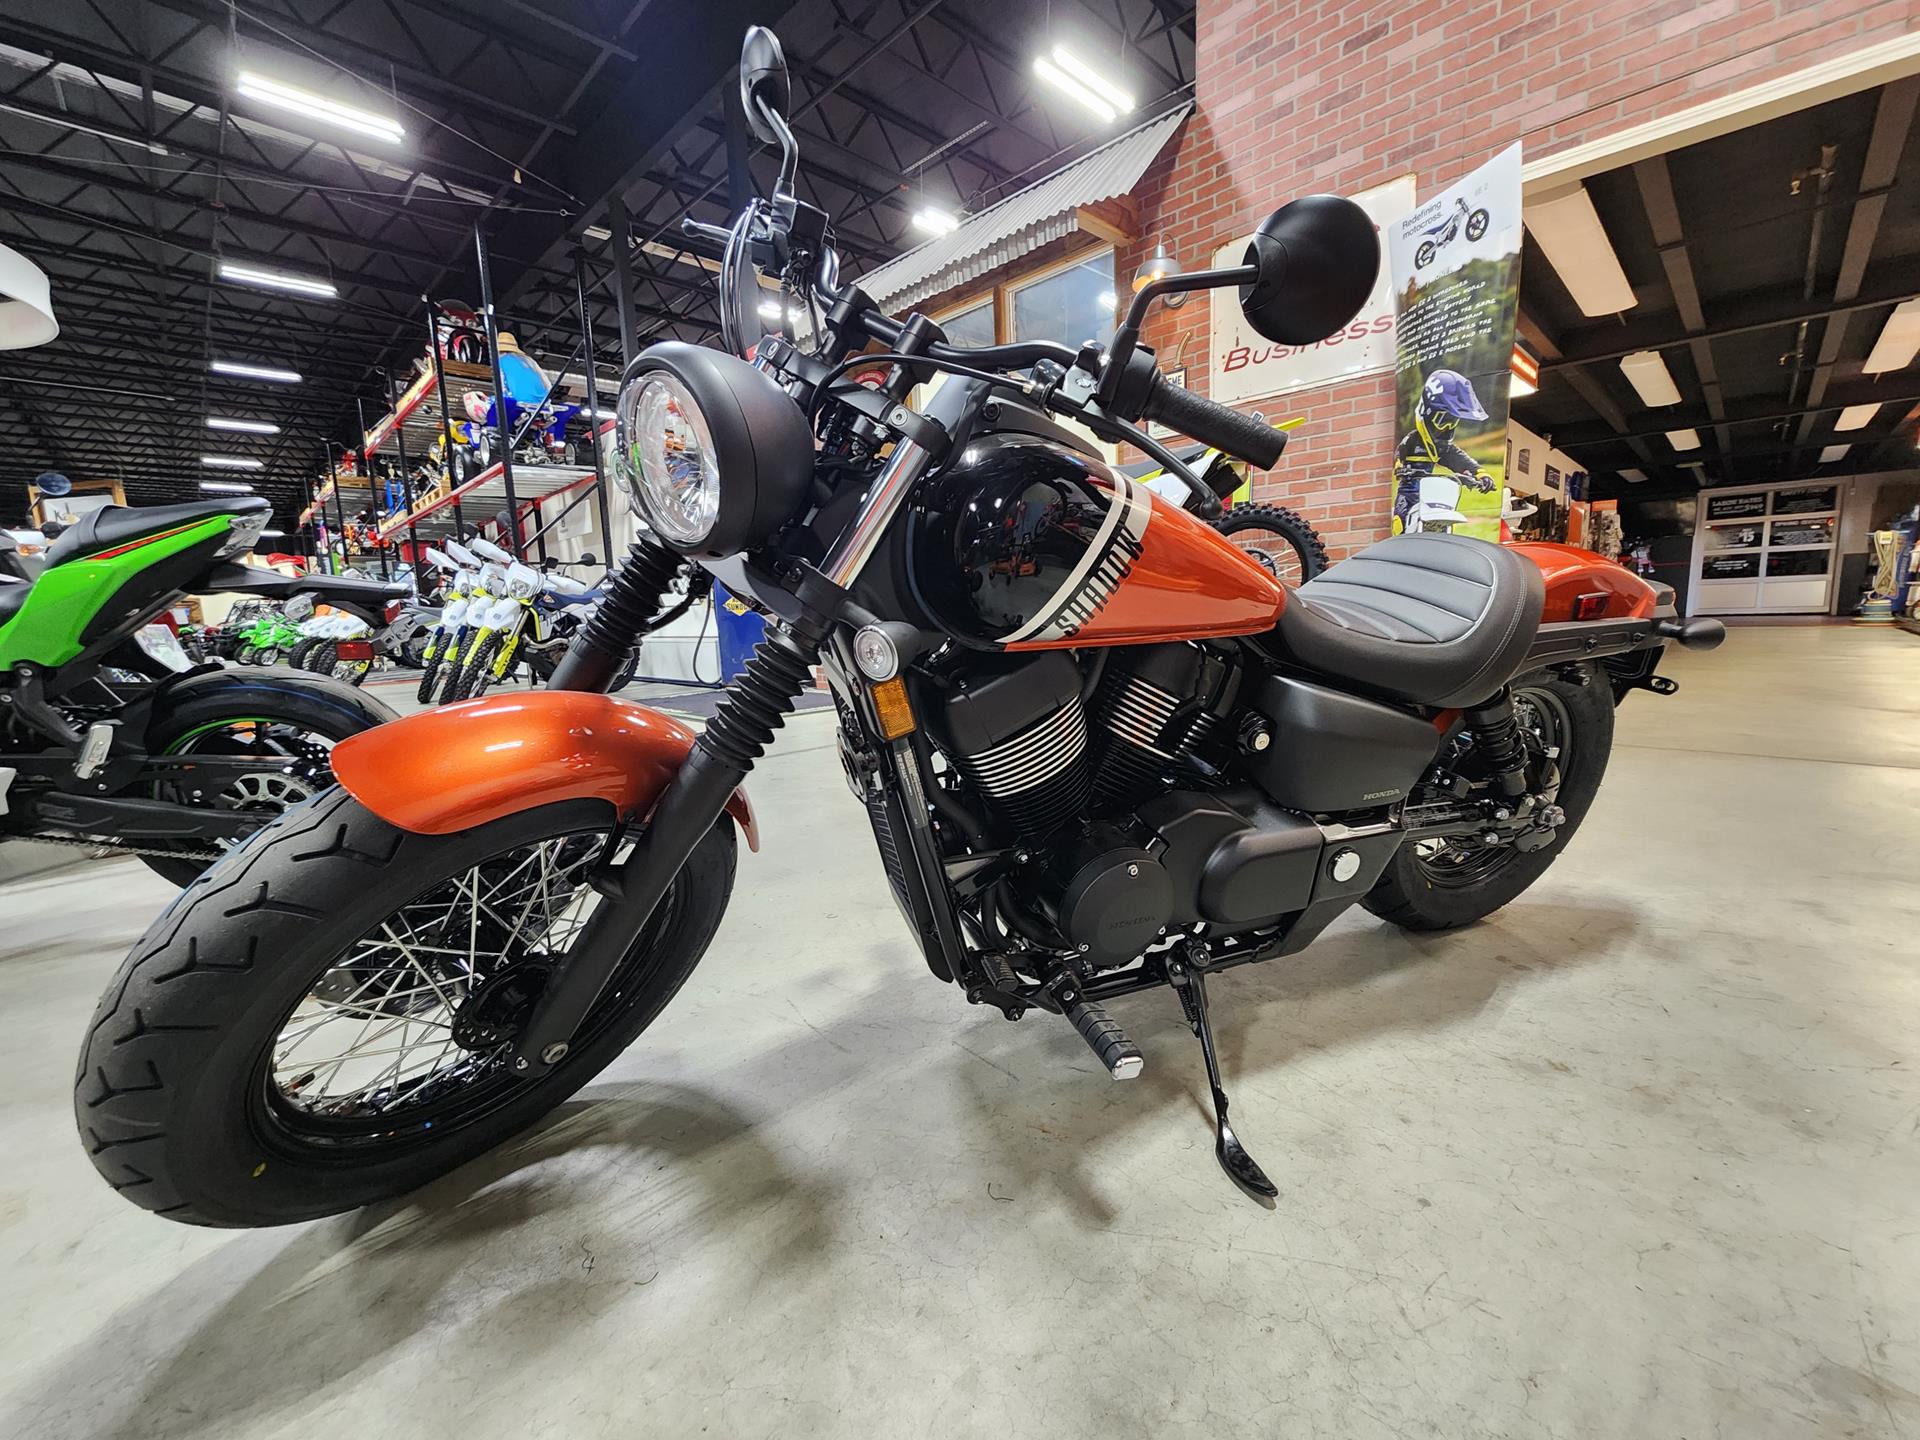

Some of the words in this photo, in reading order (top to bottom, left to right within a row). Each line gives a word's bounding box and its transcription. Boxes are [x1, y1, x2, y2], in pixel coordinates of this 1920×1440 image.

[1402, 201, 1441, 230] Redefining
[1055, 525, 1144, 637] SHADOW
[1363, 788, 1400, 800] HONDA
